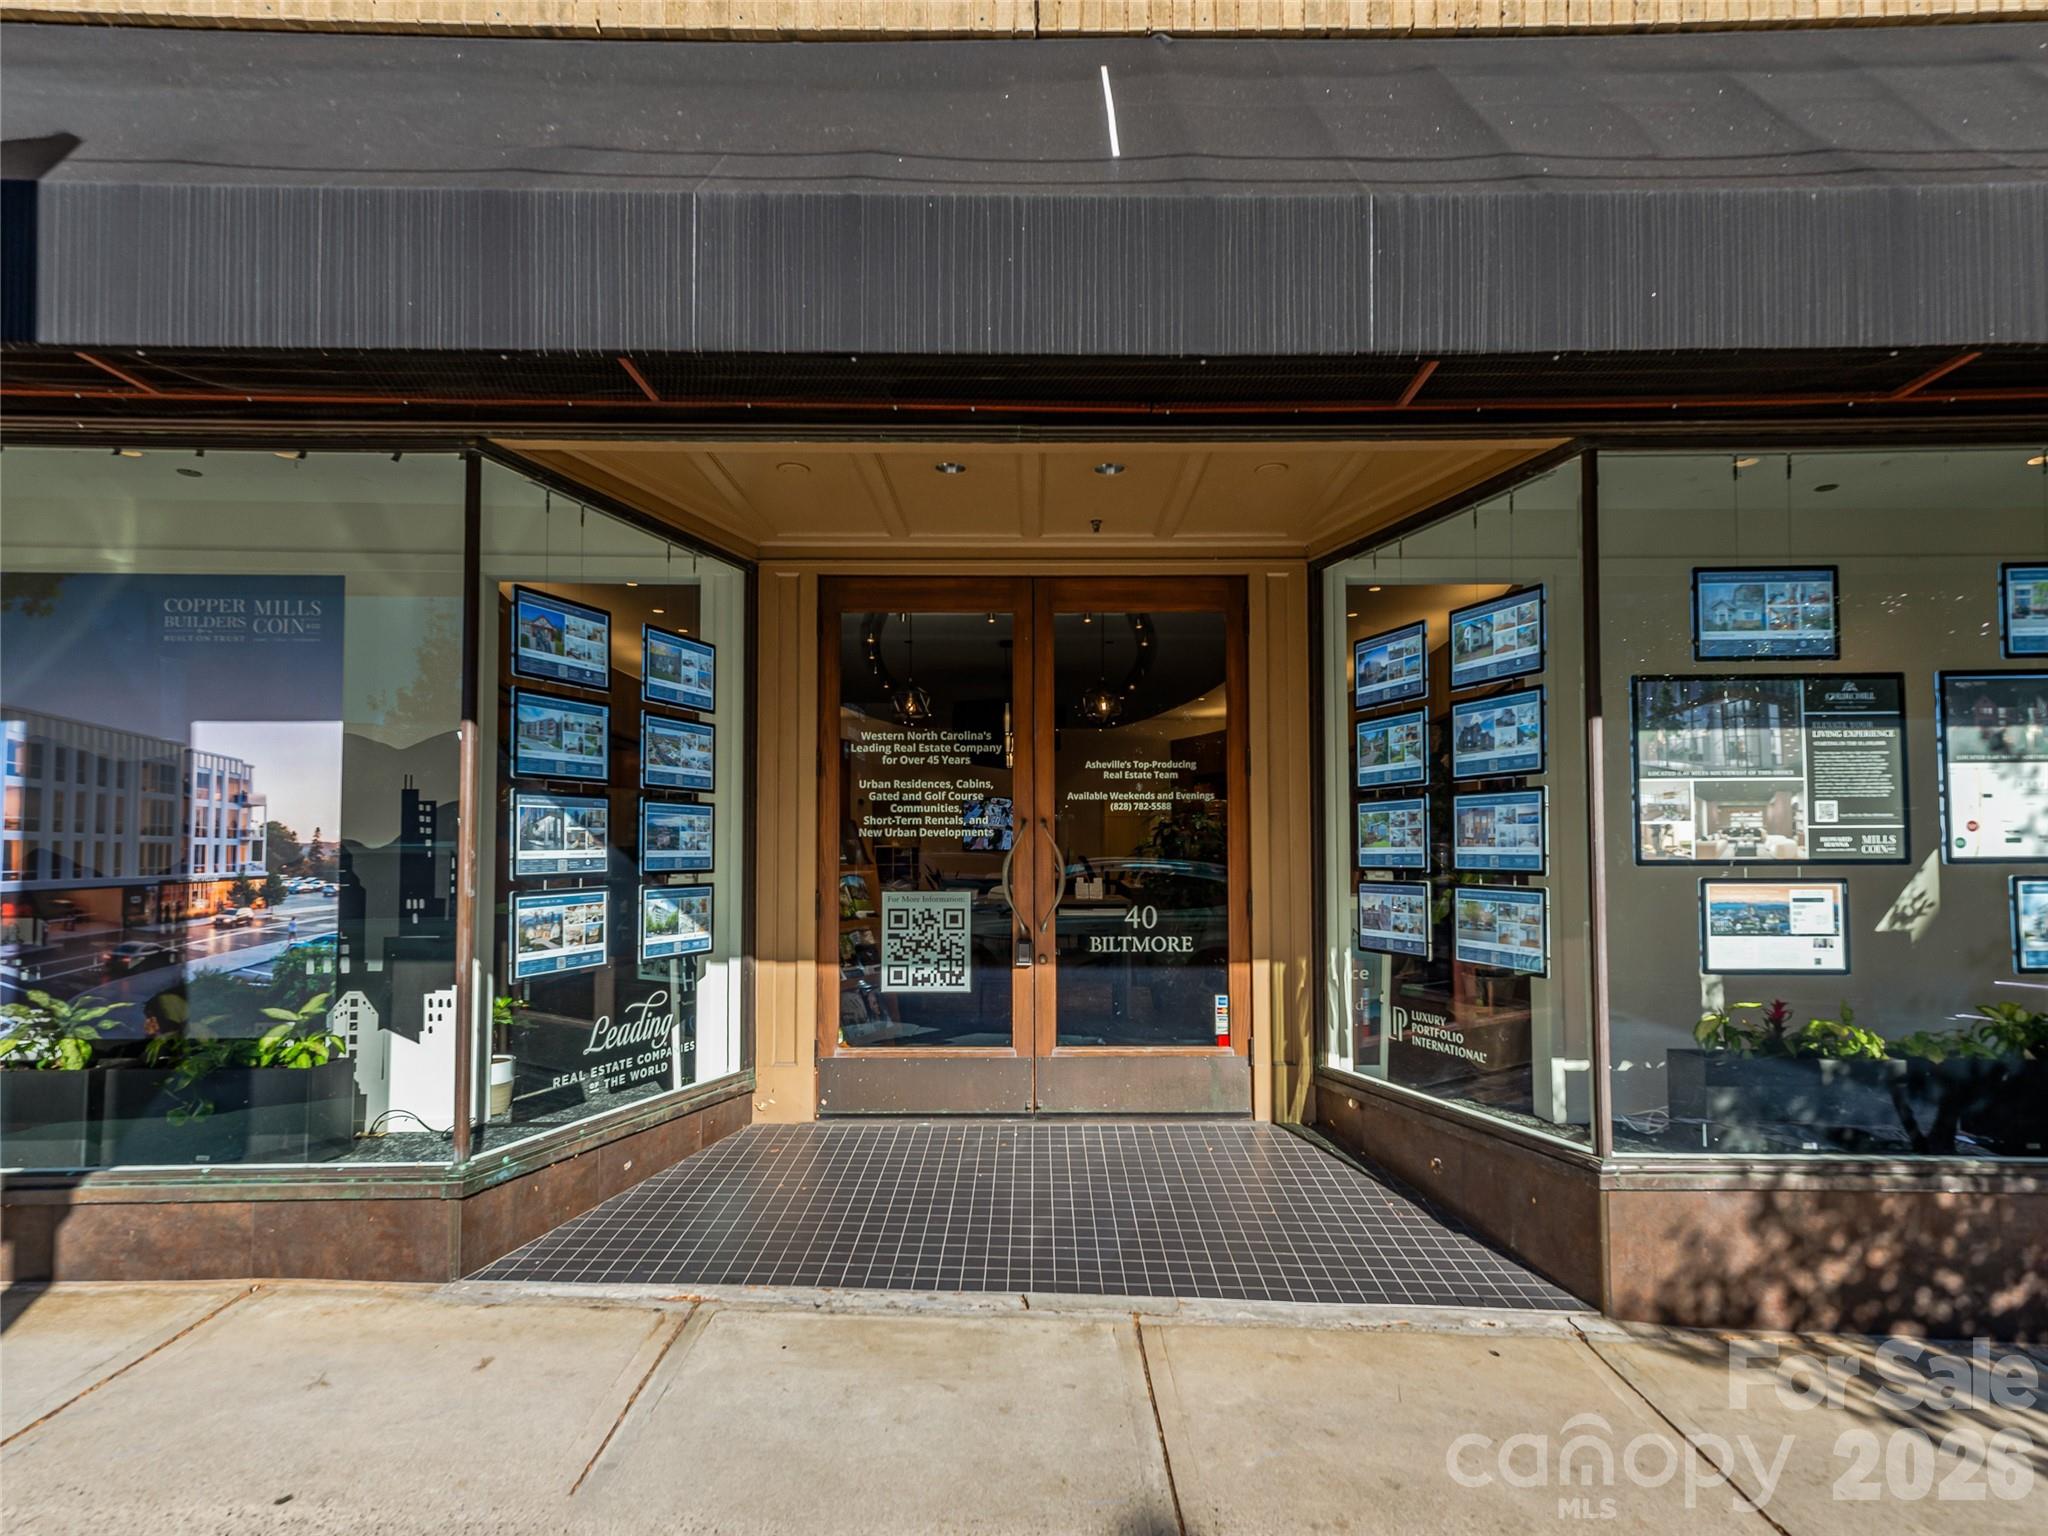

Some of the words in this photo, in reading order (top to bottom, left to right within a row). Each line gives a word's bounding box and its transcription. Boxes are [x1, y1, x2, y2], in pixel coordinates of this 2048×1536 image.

[163, 598, 245, 613] COPPER
[254, 600, 322, 616] MILLS
[163, 616, 247, 628] BUILDERS
[252, 618, 305, 634] COIN
[861, 731, 904, 741] Western
[907, 731, 938, 741] North
[940, 731, 992, 741] Carolina's
[851, 743, 892, 755] Leading
[894, 743, 916, 753] Real
[919, 743, 951, 753] Estate
[953, 743, 1002, 755] Company
[882, 755, 897, 765] for
[900, 755, 925, 765] Over
[927, 755, 940, 765] 45
[942, 755, 971, 765] Years
[1085, 760, 1132, 769] Asheville's
[1133, 760, 1197, 771] Top-Producing
[1103, 770, 1124, 779] Real
[1125, 771, 1152, 779] Estate
[1154, 771, 1179, 779] Team
[858, 779, 891, 789] Urban
[894, 779, 954, 791] Residences,
[956, 779, 994, 791] Cabins,
[868, 791, 899, 801] Gated
[902, 791, 922, 801] and
[924, 791, 946, 801] Golf
[948, 791, 984, 801] Course
[1067, 791, 1108, 800] Available
[1109, 791, 1155, 800] Weekends
[1157, 791, 1174, 800] and
[1176, 791, 1215, 802] Evenings
[890, 803, 963, 814] Communities,
[1110, 802, 1132, 812] (828)
[1134, 802, 1172, 811] 782-5588
[863, 815, 922, 826] Short-Term
[925, 815, 966, 827] Rentals,
[969, 815, 989, 825] and
[858, 828, 883, 837] New
[884, 828, 917, 837] Urban
[919, 828, 994, 840] Developments
[1124, 905, 1158, 929] 40
[1089, 936, 1194, 953] BILTMORE
[583, 990, 674, 1056] Leading
[1411, 1010, 1447, 1027] LUXURY
[1411, 1022, 1464, 1044] PORTFOLIO
[1411, 1035, 1486, 1064] INTERNATIONAL
[552, 1070, 586, 1088] REAL
[590, 1057, 633, 1079] ESTATE
[636, 1041, 695, 1063] COMPAIES
[604, 1074, 626, 1089] THE
[630, 1062, 668, 1082] WORLD
